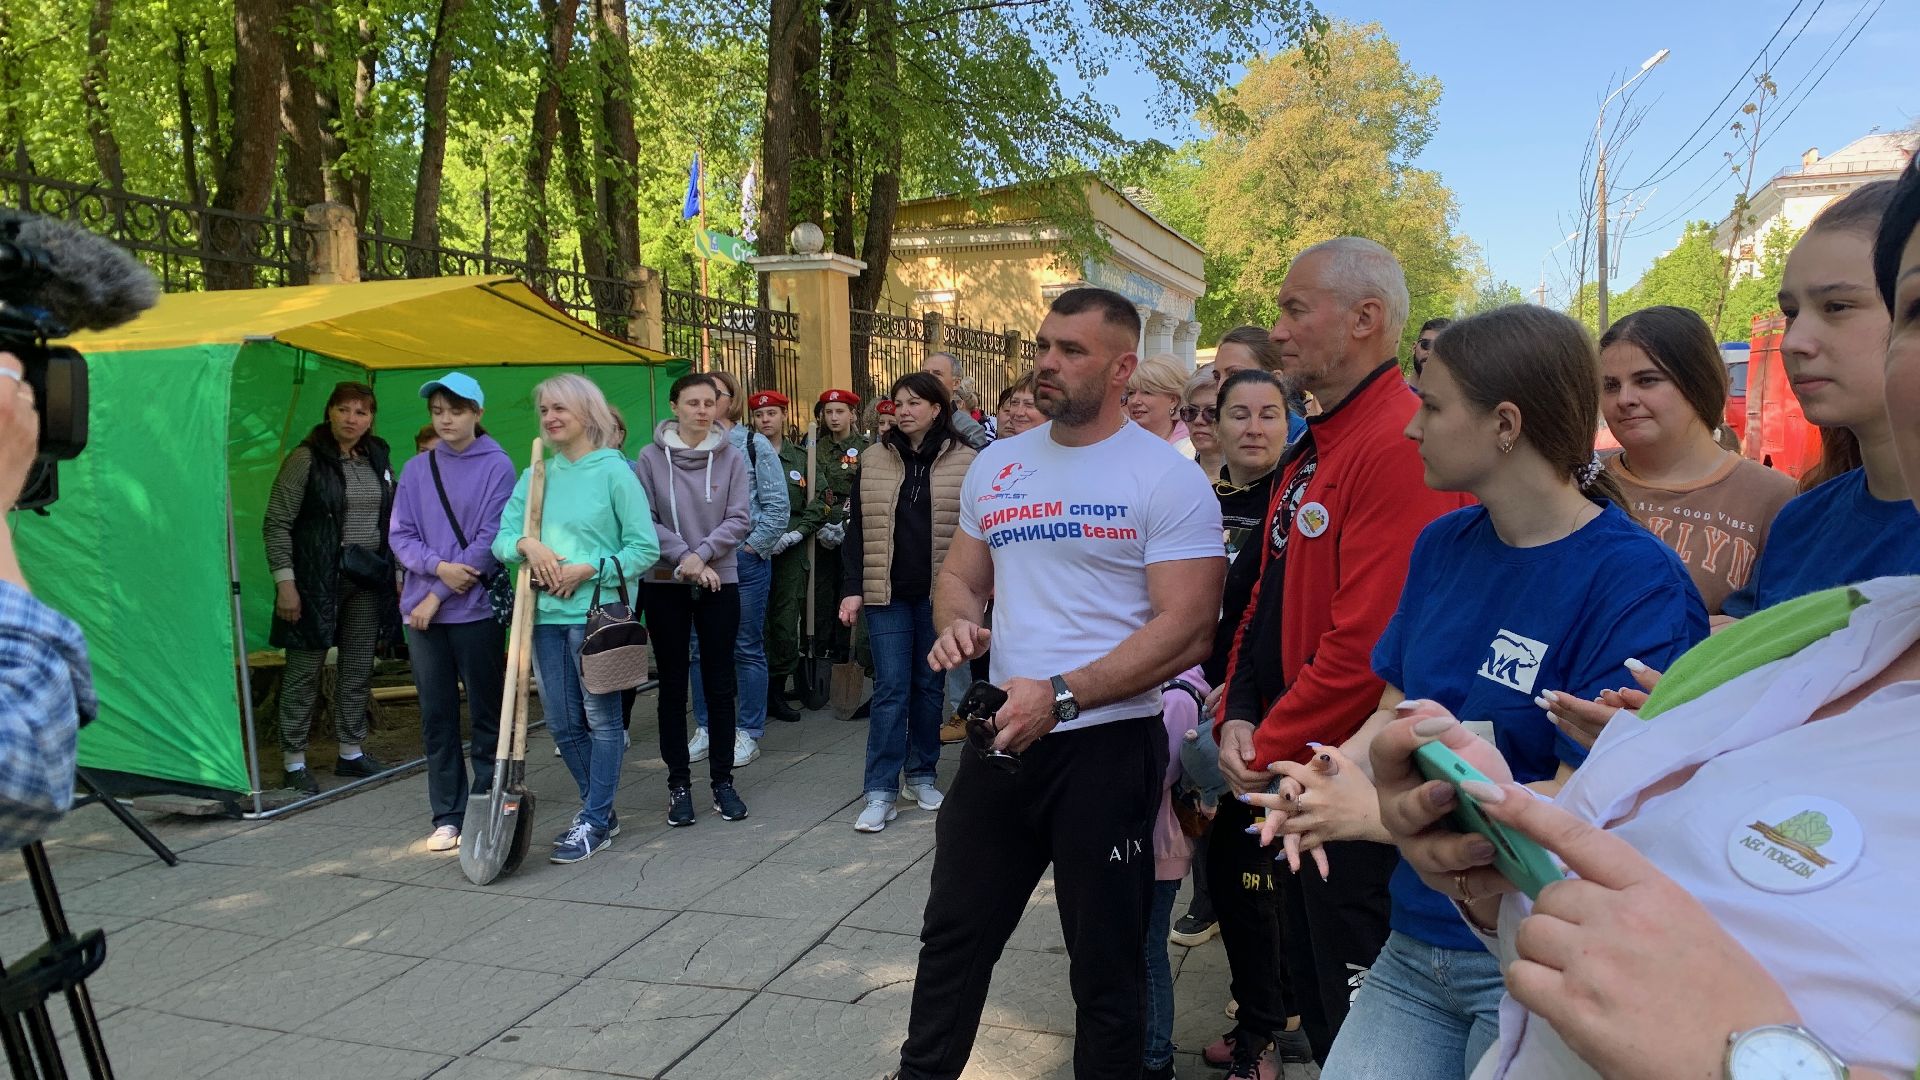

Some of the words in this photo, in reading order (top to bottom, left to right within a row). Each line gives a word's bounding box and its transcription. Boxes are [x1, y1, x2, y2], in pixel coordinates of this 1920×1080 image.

[1069, 503, 1129, 520] спорт
[1673, 507, 1711, 521] GOOD
[1739, 835, 1766, 852] ЛЕС
[1763, 846, 1817, 880] ПОБЕДЫ
